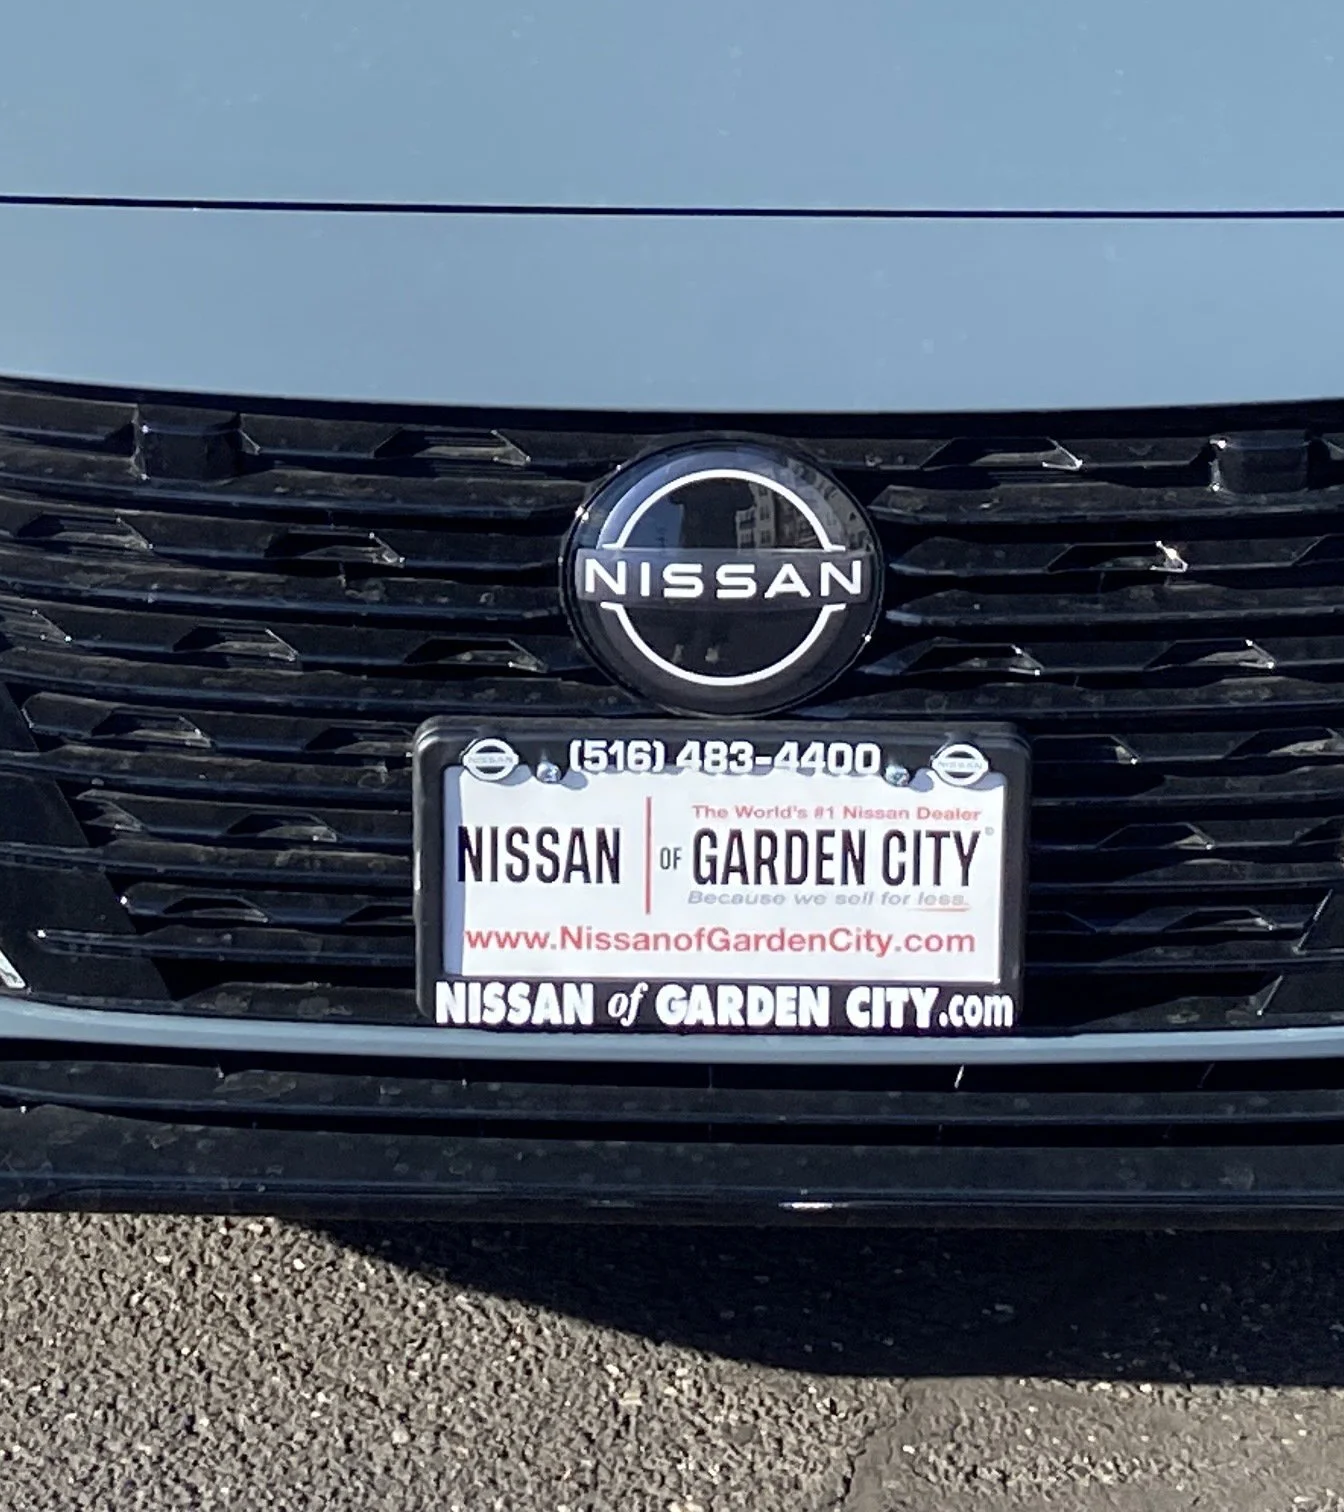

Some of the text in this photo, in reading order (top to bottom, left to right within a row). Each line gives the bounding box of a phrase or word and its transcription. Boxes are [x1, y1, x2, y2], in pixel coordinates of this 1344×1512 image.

[584, 558, 862, 600] NISSAN
[569, 739, 882, 777] (516) 483-4400
[692, 805, 982, 821] The World's #1 Nissan Dealer
[457, 825, 621, 885] NISSAN
[659, 827, 982, 887] OF GARDEN CITY
[687, 890, 786, 905] Because
[794, 893, 827, 906] we
[835, 891, 874, 906] sell
[881, 891, 911, 906] for
[464, 925, 976, 958] www.NissanofGardenCity.com
[435, 981, 1015, 1029] NISSAN of GARDEN CITY.com
